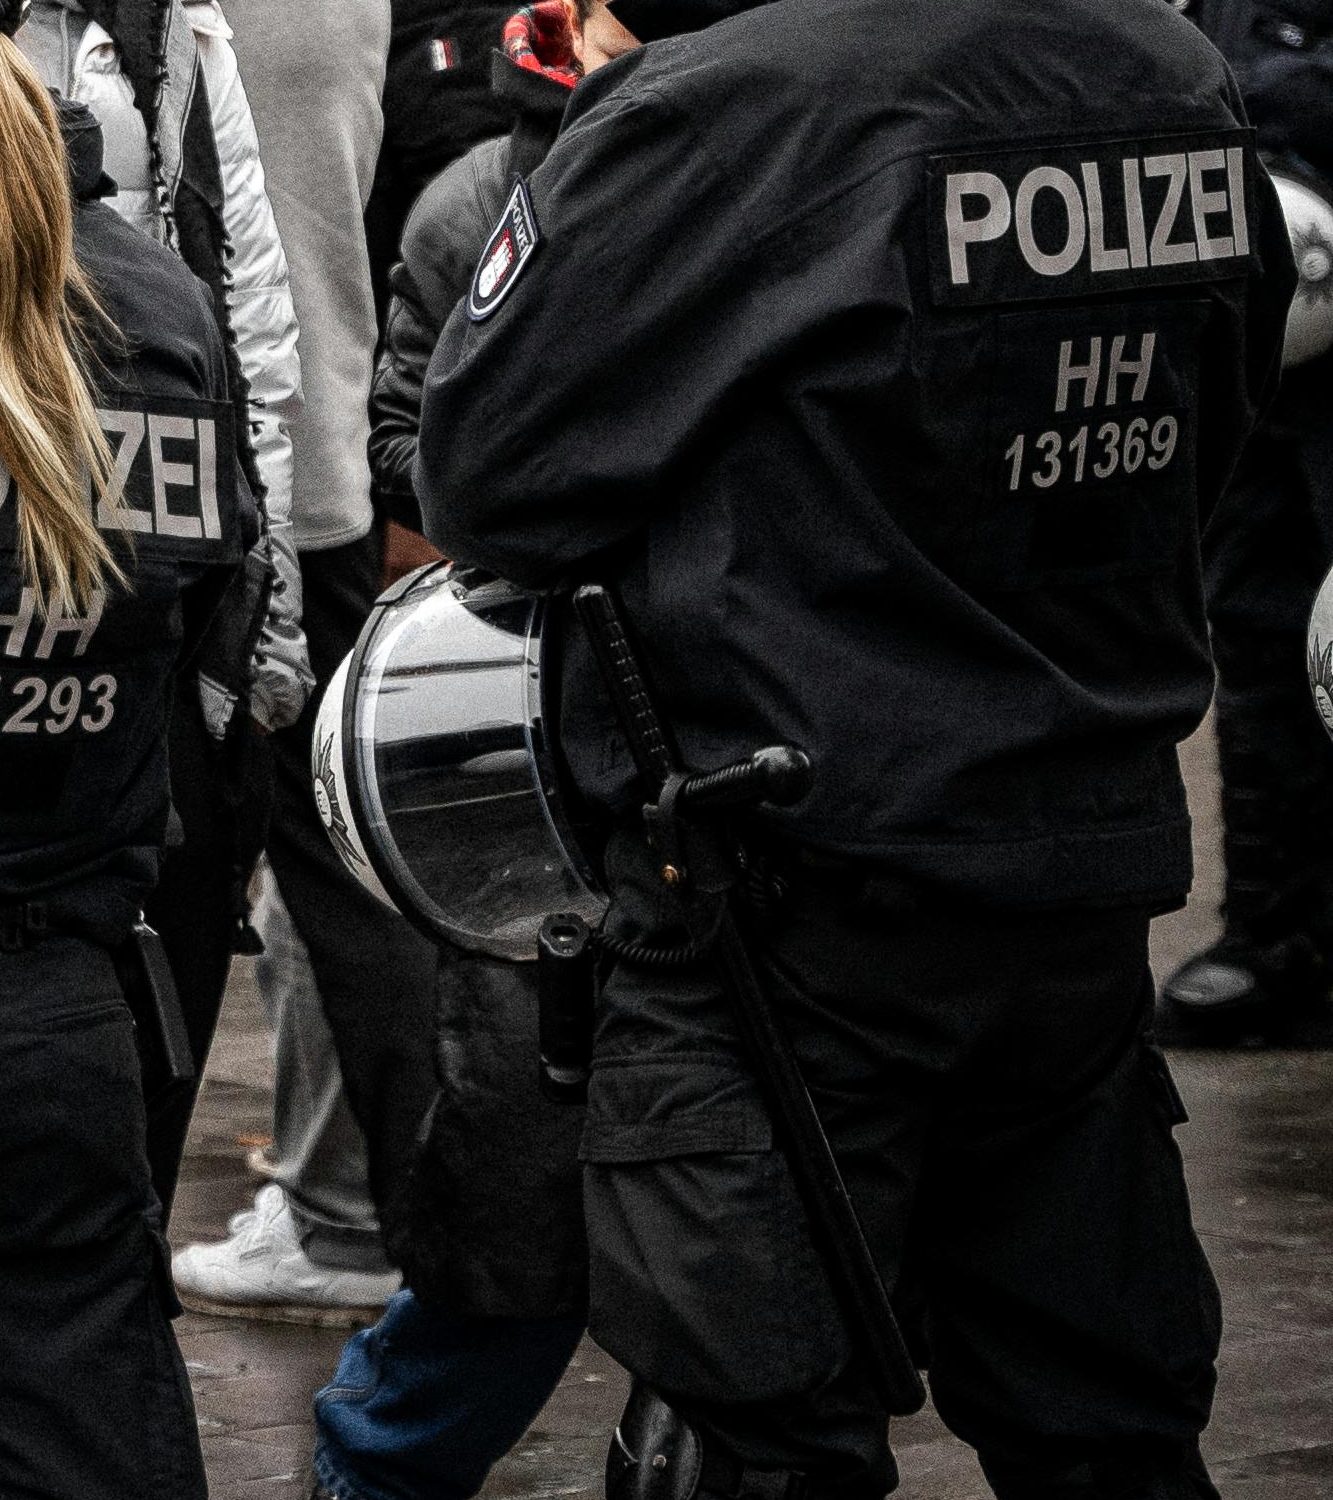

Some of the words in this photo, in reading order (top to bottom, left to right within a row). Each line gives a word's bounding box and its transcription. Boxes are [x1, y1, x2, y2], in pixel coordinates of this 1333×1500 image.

[945, 146, 1251, 285] POLIZEI
[1054, 331, 1157, 413] HH
[1004, 415, 1179, 491] 131369
